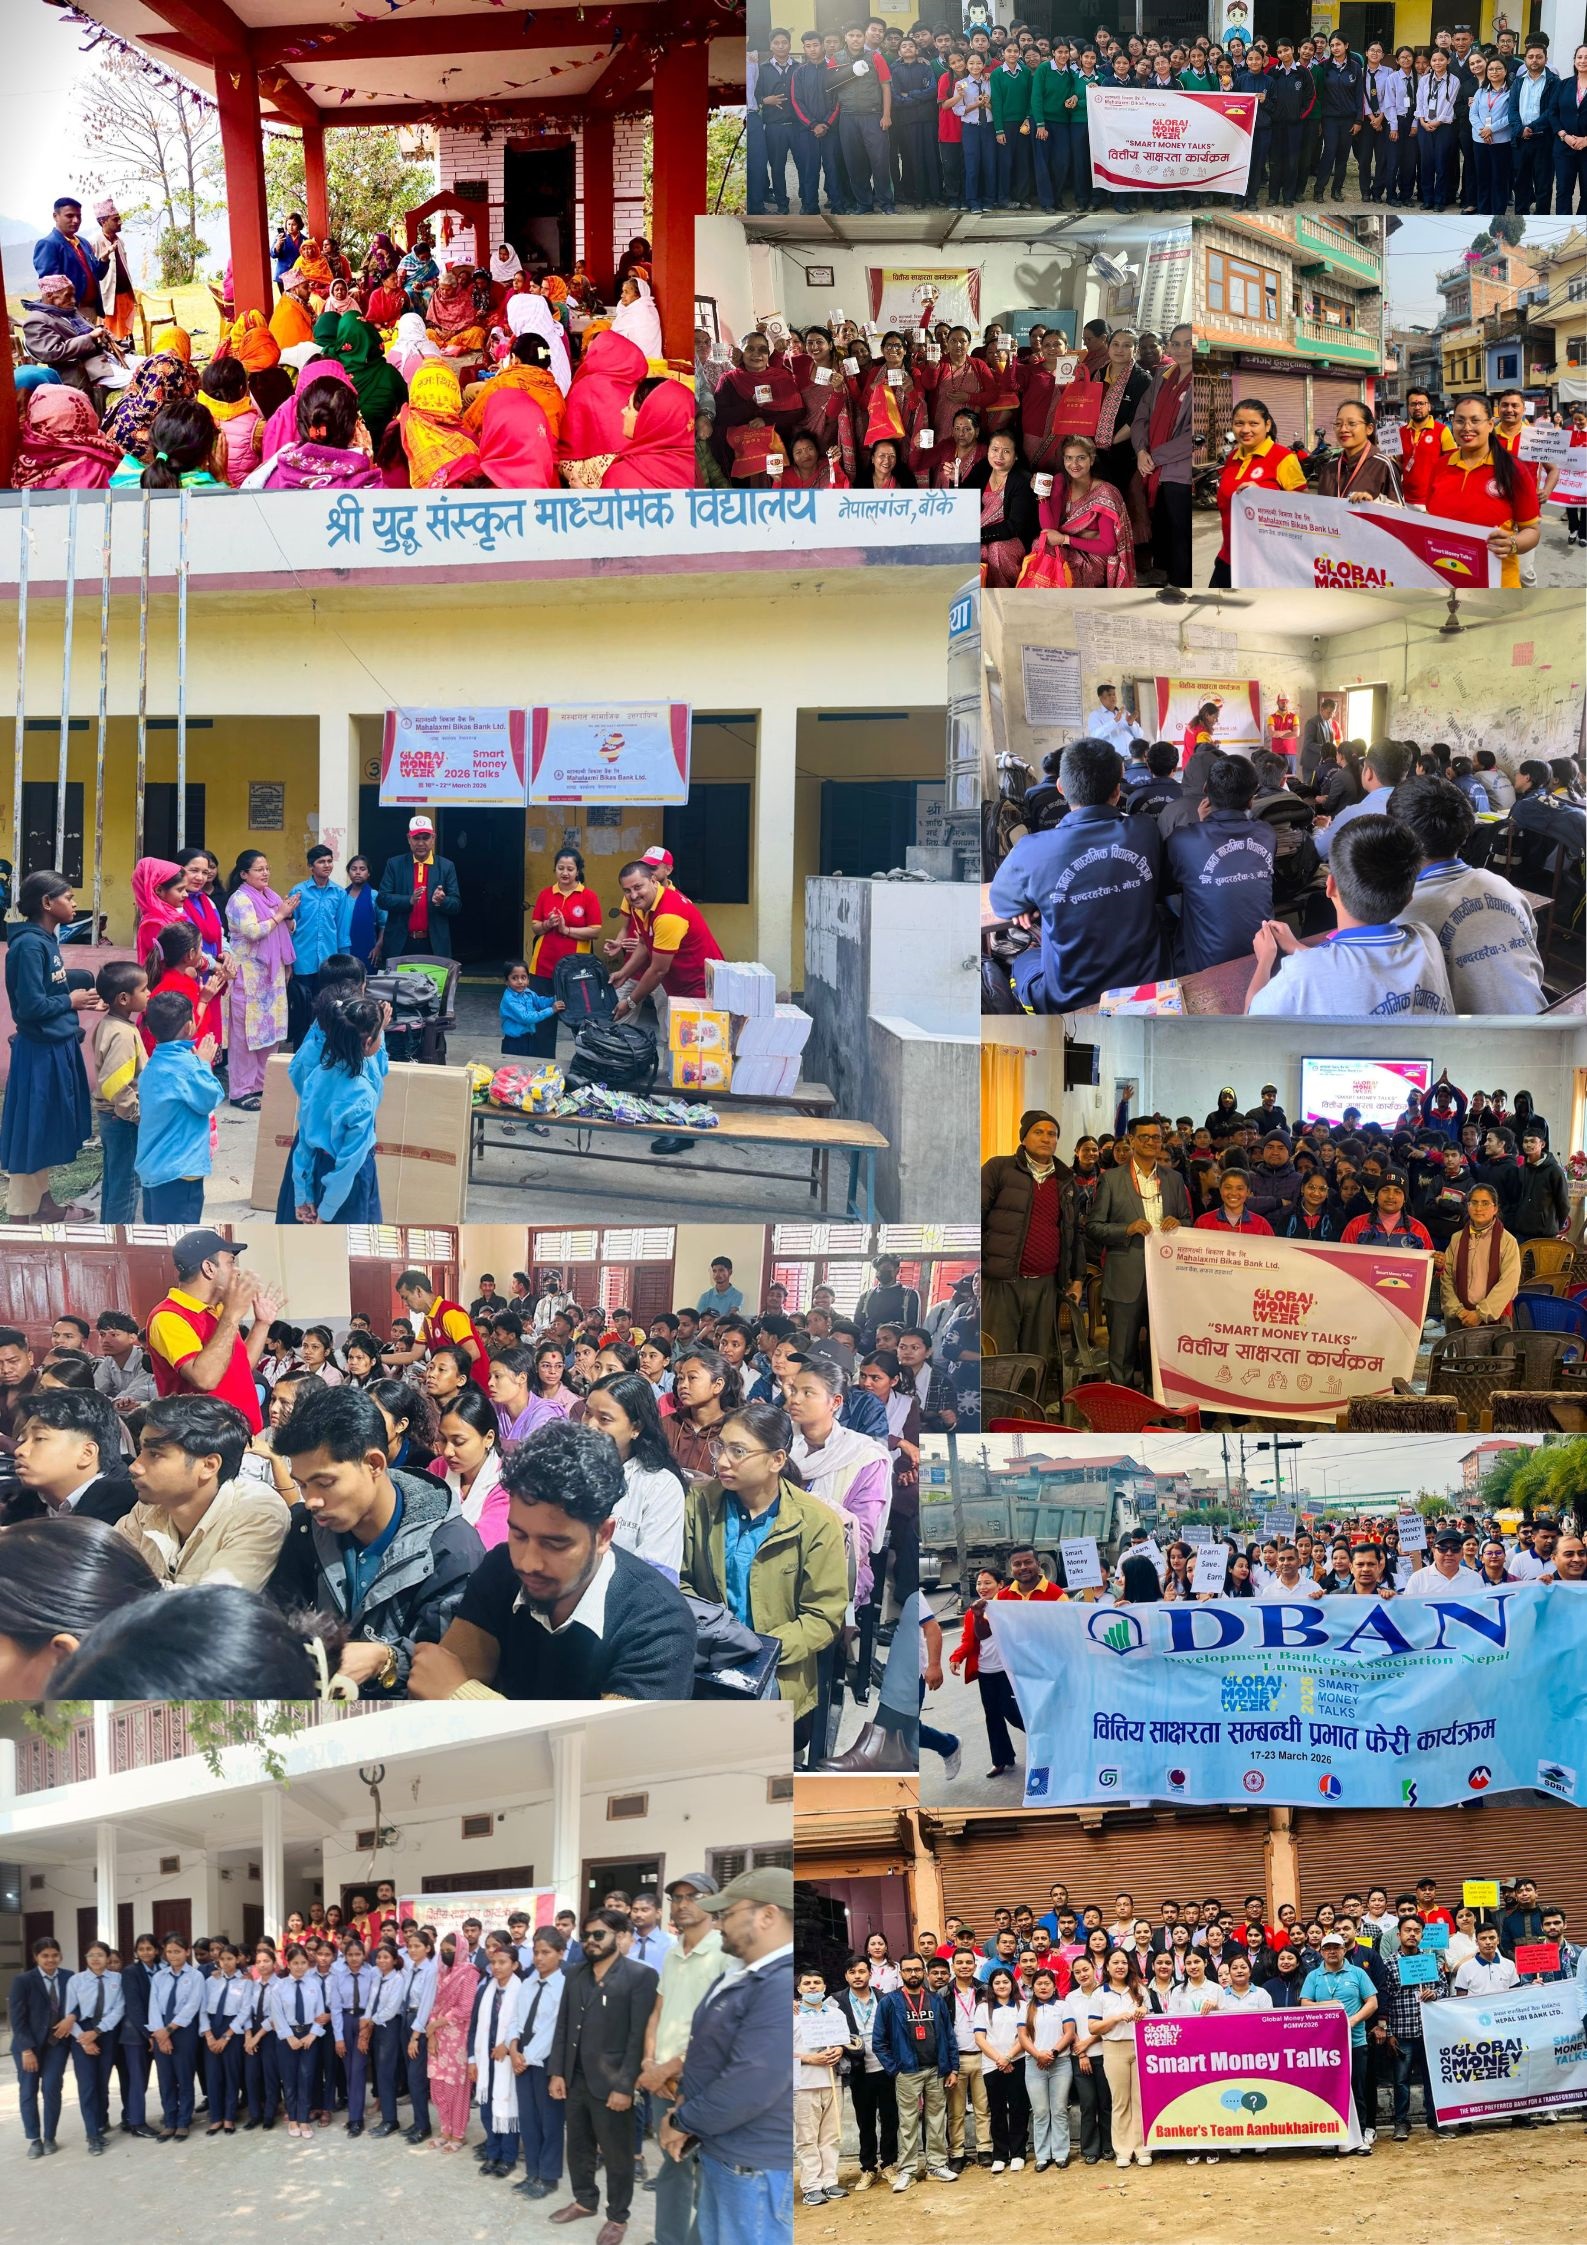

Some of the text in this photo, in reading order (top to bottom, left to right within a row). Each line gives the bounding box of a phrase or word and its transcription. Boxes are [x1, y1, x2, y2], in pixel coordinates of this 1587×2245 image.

[1152, 126, 1187, 134] MONEY
[1152, 132, 1181, 140] WEEK
[1108, 148, 1230, 163] वित्तीय साक्षरता कार्यक्रम
[326, 494, 364, 548] श्री
[426, 496, 527, 551] संस्कृत
[535, 489, 674, 534] माध्यमिक
[685, 489, 824, 529] विद्यालय
[1258, 515, 1341, 536] Mahalaxmi Bikas Bank Ltd.
[1430, 546, 1472, 561] Smart Money Talks
[1314, 557, 1394, 587] GLOBAL
[400, 752, 448, 760] GLOBAL
[473, 750, 504, 758] Smart
[400, 760, 444, 768] MONEY
[473, 760, 507, 770] Money
[400, 768, 470, 778] WEEK 2026
[473, 770, 500, 778] Talks
[1216, 838, 1245, 858] माध्यमिक
[1246, 838, 1268, 858] विद्यालय
[1055, 868, 1076, 892] जनता
[1070, 848, 1108, 872] माध्यमिक
[1111, 844, 1140, 865] विद्यालय
[1449, 896, 1484, 925] माध्यमिक
[1484, 892, 1516, 917] विद्यालय
[1176, 1254, 1280, 1270] Mahalaxmi Bikas Bank Ltd.
[1254, 1288, 1318, 1305] GLOBAL
[1254, 1300, 1312, 1315] MONEY
[1254, 1311, 1300, 1326] WEEK
[1262, 1328, 1308, 1342] MONEY
[1177, 1335, 1384, 1373] वित्तीय साक्षरता कार्यक्रम
[1400, 1526, 1422, 1534] MONEY
[1200, 1548, 1221, 1556] Learn.
[1066, 1558, 1088, 1566] Money
[1201, 1560, 1220, 1568] Save.
[1206, 1573, 1225, 1581] Earn.
[1159, 1593, 1516, 1657] DBAN
[1164, 1651, 1511, 1670] Development Bankers Association Nepal
[1264, 1662, 1406, 1680] Lumini Province
[1221, 1687, 1360, 1705] MONEY MONEY
[1222, 1676, 1360, 1716] GLOBAL 2026 SMART
[1221, 1699, 1356, 1719] WEEK TALKS
[1093, 1712, 1496, 1756] वित्तिय साक्षरता सम्बन्धी प्रभात फेरी कार्यक्रम
[1250, 1751, 1332, 1764] 17-23 March 2026
[1544, 1779, 1568, 1794] SDBL
[1284, 2014, 1305, 2022] Money
[1495, 2016, 1516, 2025] NEPAL
[1528, 2012, 1548, 2020] BANK
[1548, 2008, 1564, 2017] LTD.
[1144, 2024, 1182, 2033] GLOBAL
[1283, 2022, 1319, 2030] #GMW2026
[1144, 2032, 1179, 2040] MONEY
[1144, 2039, 1174, 2047] WEEK
[1553, 2033, 1587, 2046] SMAR
[1451, 2038, 1530, 2058] GLOBAL
[1146, 2048, 1341, 2074] Smart Money Talks
[1440, 2047, 1523, 2084] 2026 MONEY
[1453, 2065, 1512, 2084] WEEK
[1460, 2108, 1470, 2116] THE
[1470, 2105, 1484, 2114] MOST
[1484, 2102, 1513, 2113] PREFERRED
[1514, 2100, 1528, 2109] BANK
[1528, 2098, 1538, 2106] FOR
[1542, 2092, 1584, 2103] TRANSFORMING
[1156, 2120, 1340, 2138] Banker's Team Aanbukhaireni
